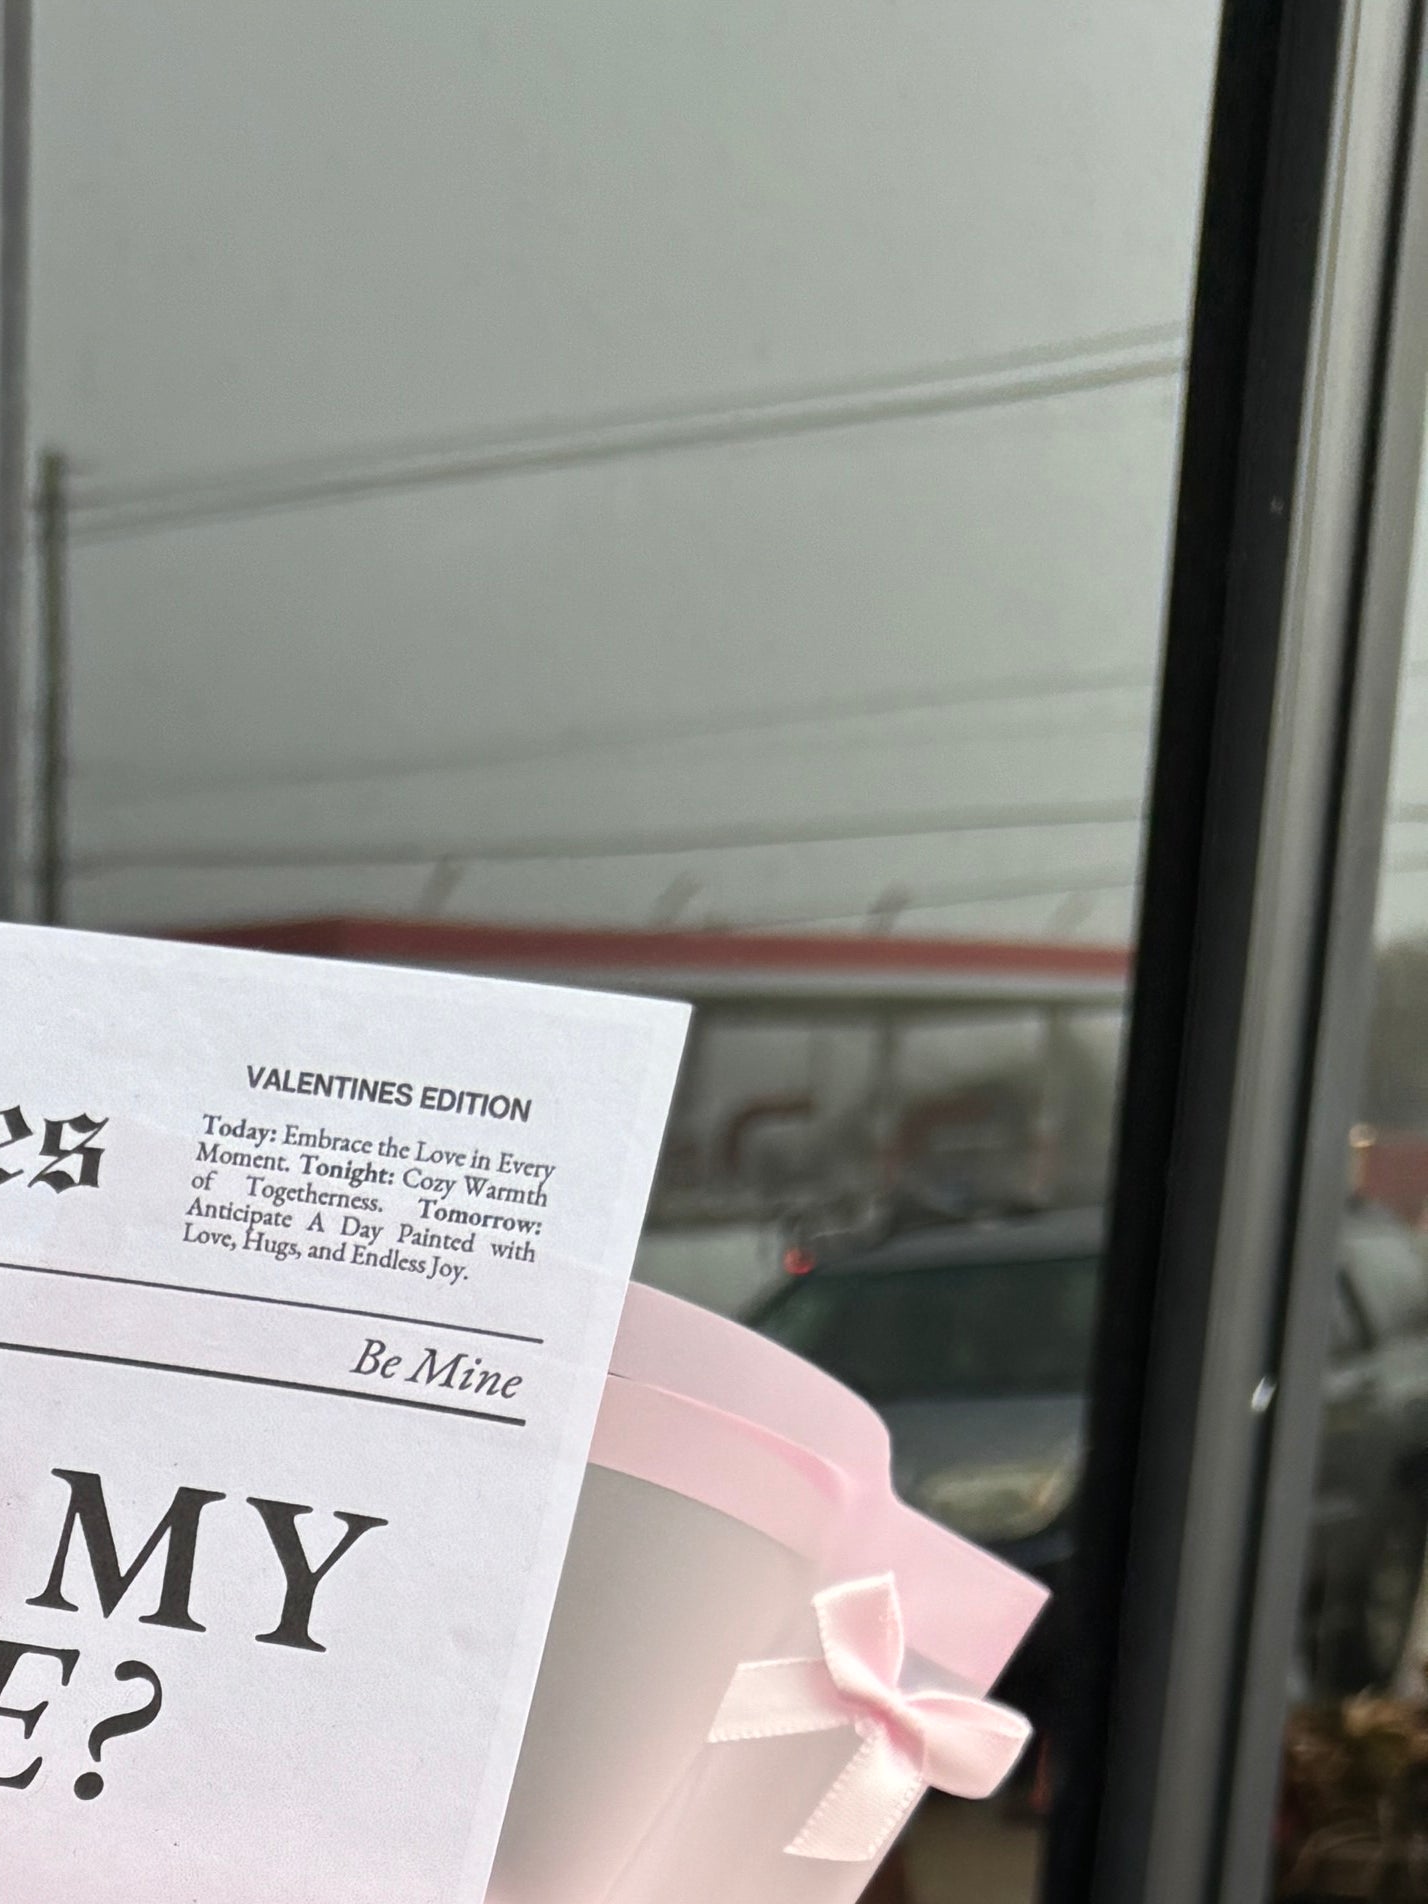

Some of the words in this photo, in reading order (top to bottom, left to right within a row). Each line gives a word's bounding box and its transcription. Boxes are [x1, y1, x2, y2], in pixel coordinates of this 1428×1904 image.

[246, 1065, 413, 1108] VALENTINES
[419, 1086, 533, 1123] EDITION
[195, 1142, 290, 1173] Moment.
[299, 1154, 395, 1188] Tonight:
[402, 1167, 458, 1200] Cozy
[464, 1175, 548, 1207] Warmth
[203, 1114, 277, 1148] Today:
[282, 1124, 373, 1155] Embrace
[378, 1136, 410, 1160] the
[414, 1141, 467, 1168] Love
[469, 1149, 491, 1171] in
[496, 1152, 556, 1187] Every
[185, 1197, 293, 1233] Anticipate
[306, 1212, 325, 1233] A
[340, 1215, 384, 1246] Day
[396, 1223, 476, 1253] Painted
[490, 1241, 536, 1263] with
[190, 1170, 218, 1192] of
[246, 1174, 383, 1213] Togetherness.
[418, 1198, 543, 1235] Tomorrow:
[182, 1222, 237, 1251] Love,
[242, 1230, 302, 1262] Hugs,
[307, 1242, 345, 1262] and
[349, 1244, 427, 1274] Endless
[426, 1256, 469, 1286] Joy.
[348, 1338, 402, 1380] Be
[404, 1347, 524, 1400] Mine
[24, 1466, 389, 1655] MY
